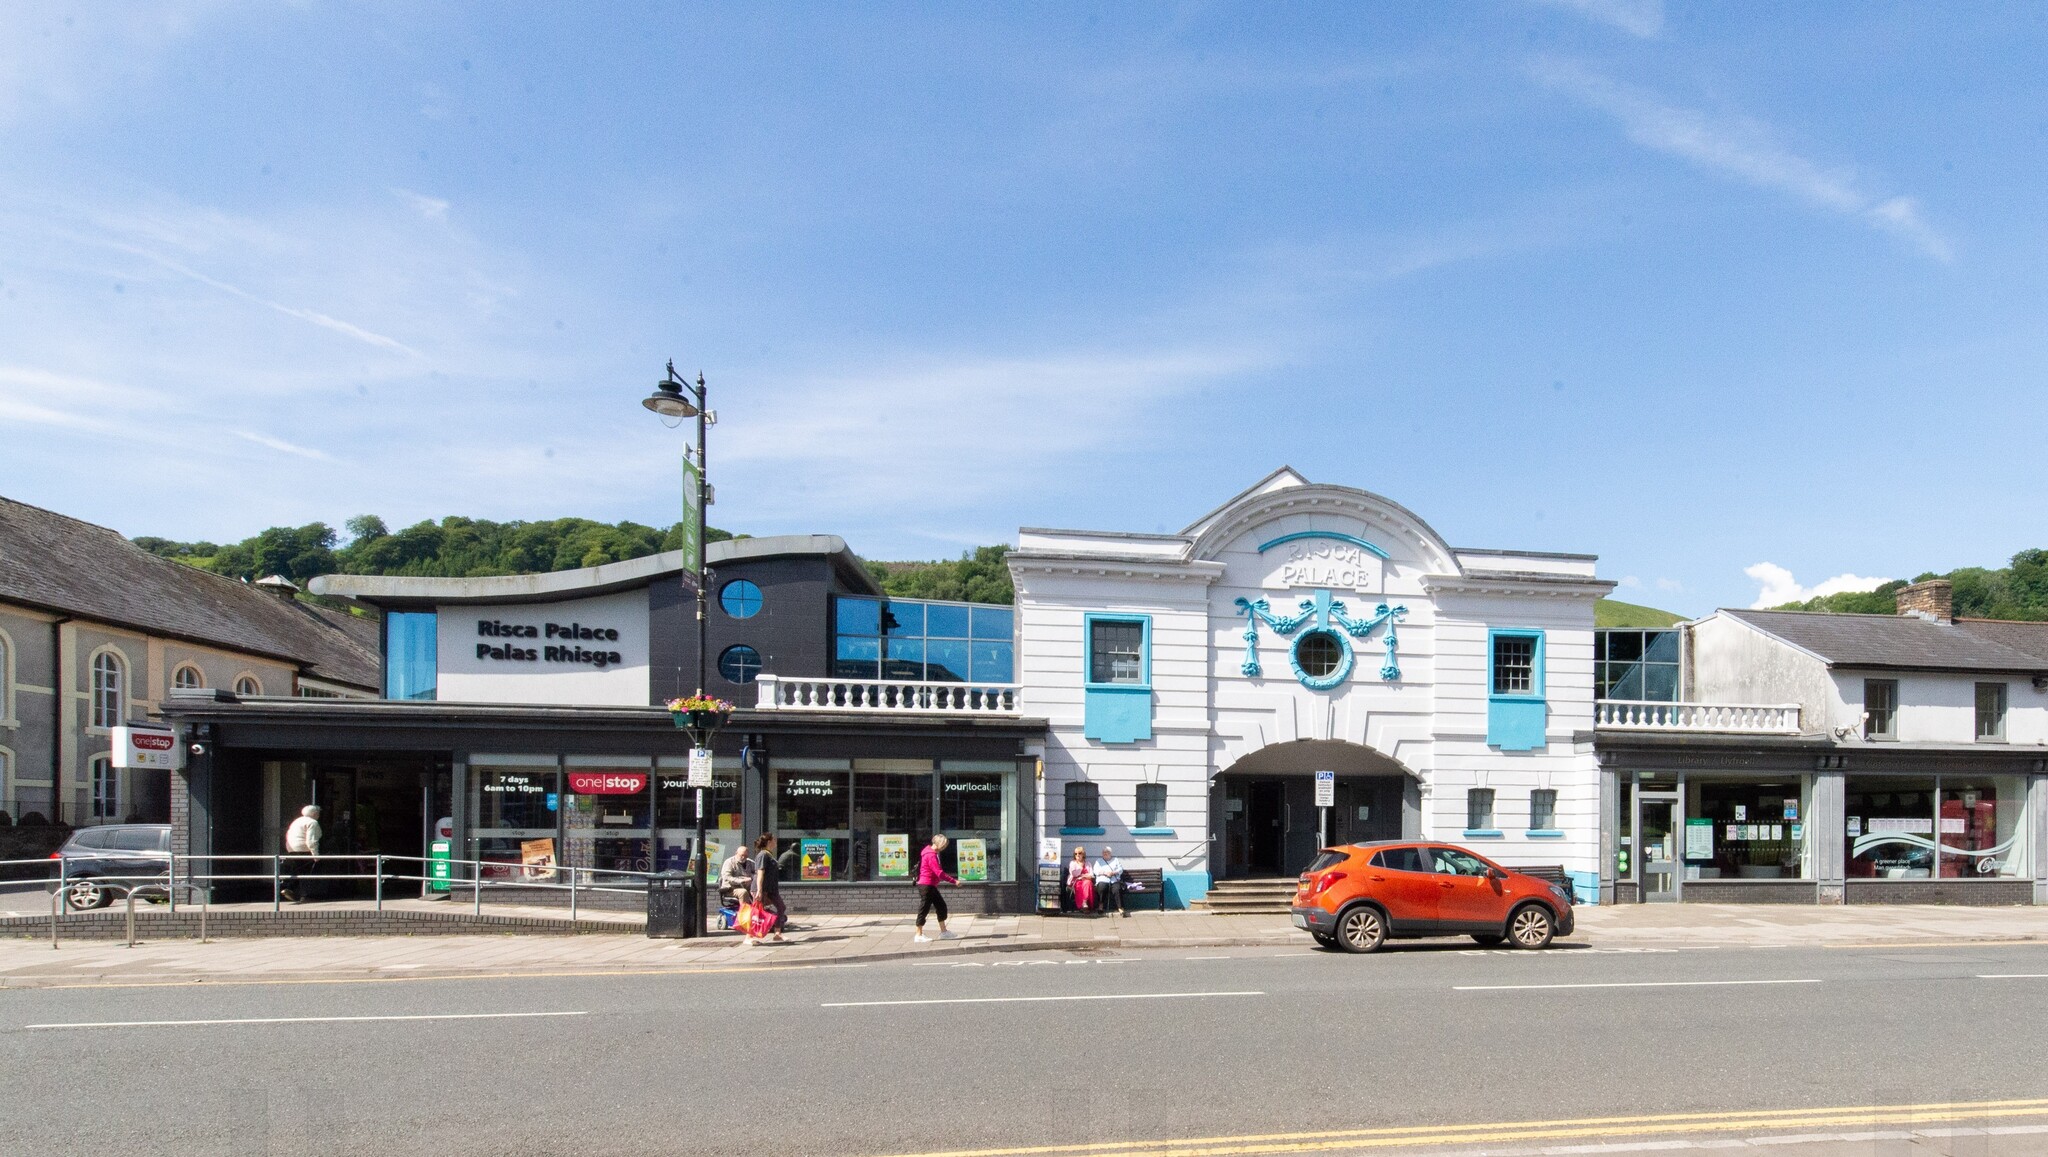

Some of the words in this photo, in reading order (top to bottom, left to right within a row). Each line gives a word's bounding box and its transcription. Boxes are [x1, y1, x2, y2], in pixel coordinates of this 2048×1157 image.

[1282, 566, 1369, 587] PALACE
[477, 620, 538, 638] Risca
[545, 622, 619, 641] Palace
[476, 643, 538, 661] Palas
[544, 645, 621, 667] Rhisga
[1678, 756, 1707, 765] Library
[508, 776, 529, 784] days
[518, 785, 543, 793] 10pm
[793, 788, 804, 796] yb
[822, 788, 833, 796] yh
